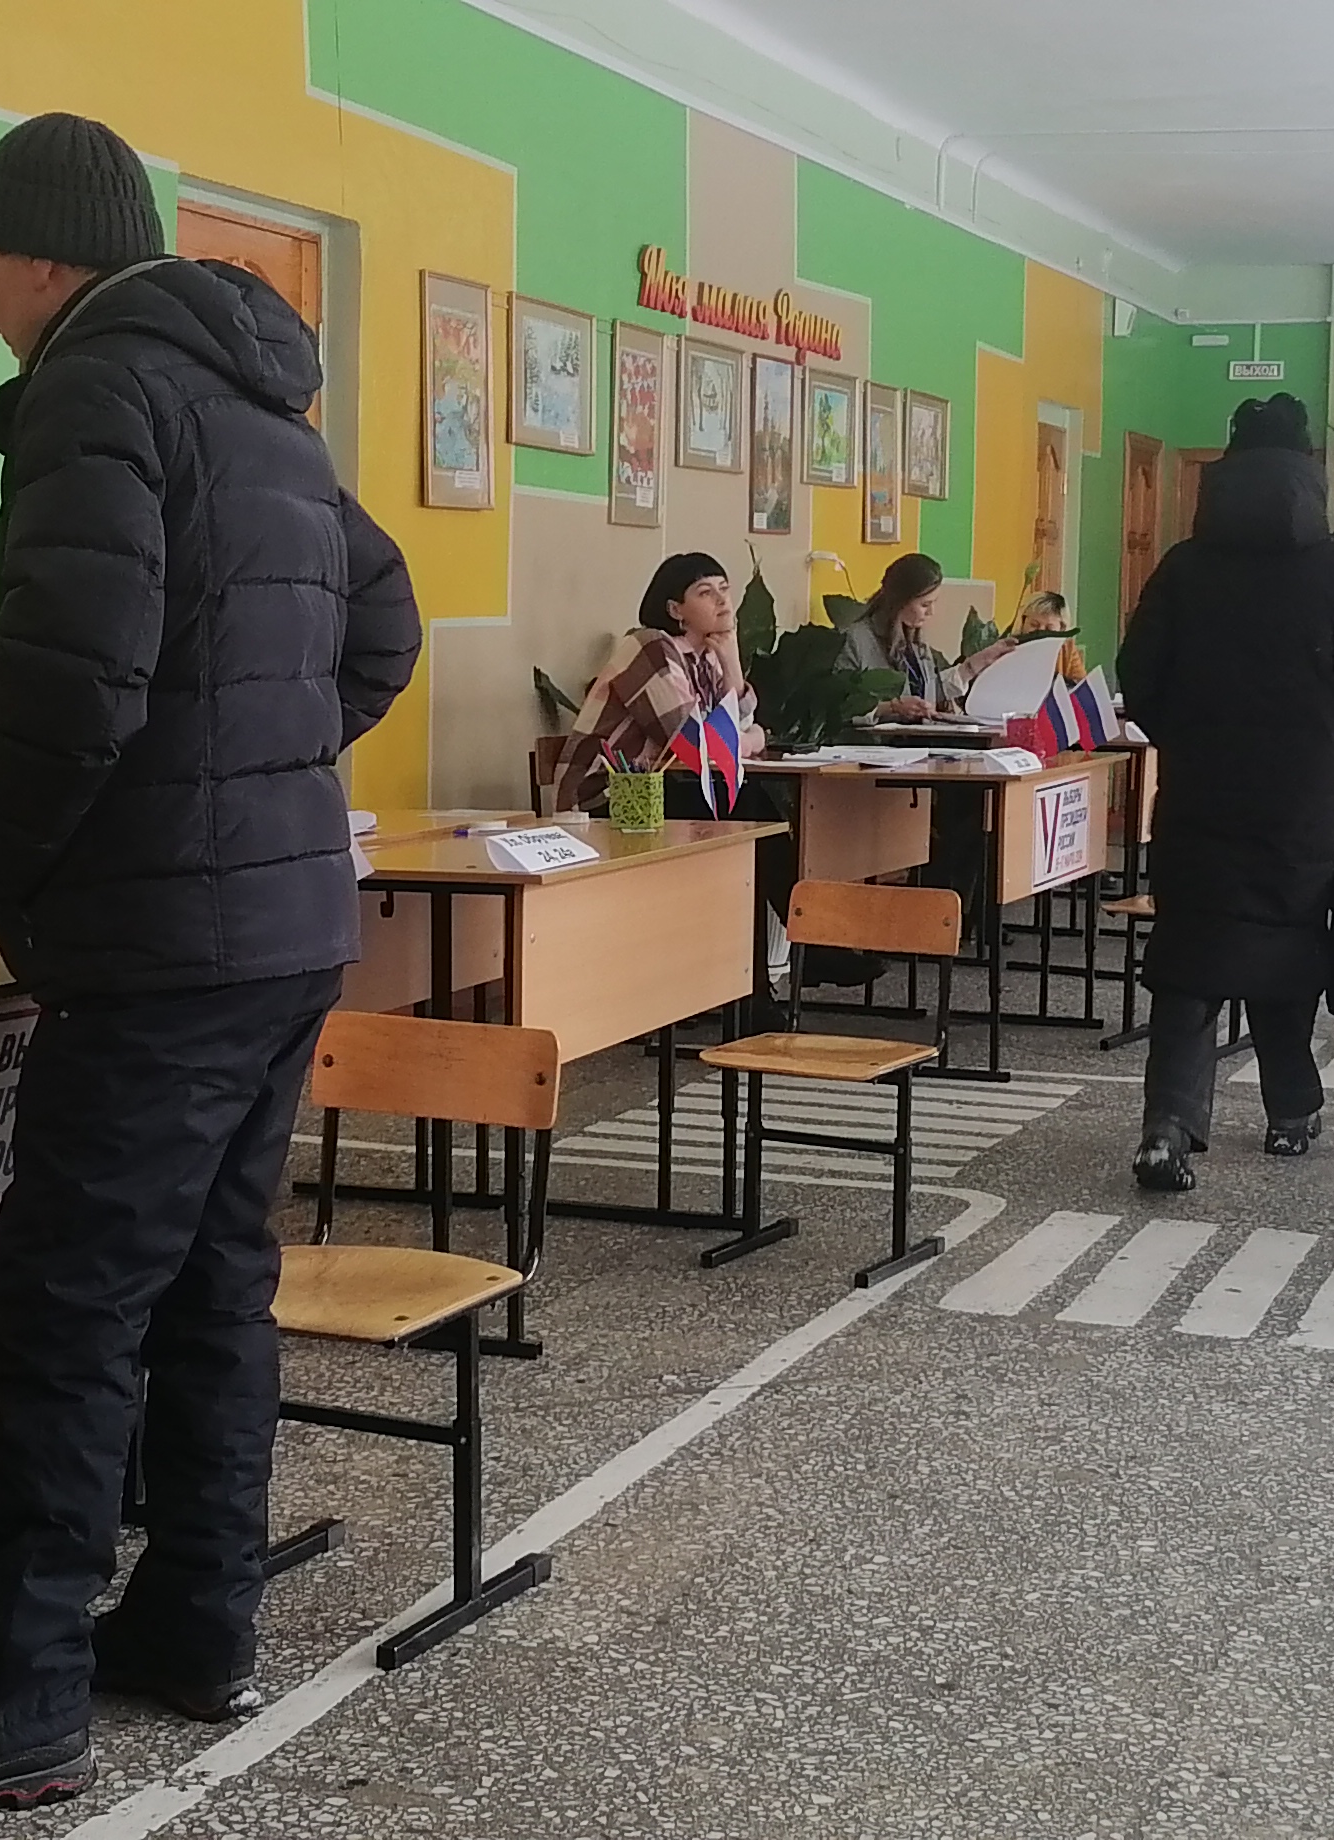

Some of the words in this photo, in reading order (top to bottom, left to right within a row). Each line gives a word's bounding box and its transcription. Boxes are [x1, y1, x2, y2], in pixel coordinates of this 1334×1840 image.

[638, 244, 688, 318] Моя
[692, 281, 769, 340] малая
[774, 288, 841, 365] Родина
[1234, 365, 1278, 376] ВЫХОД
